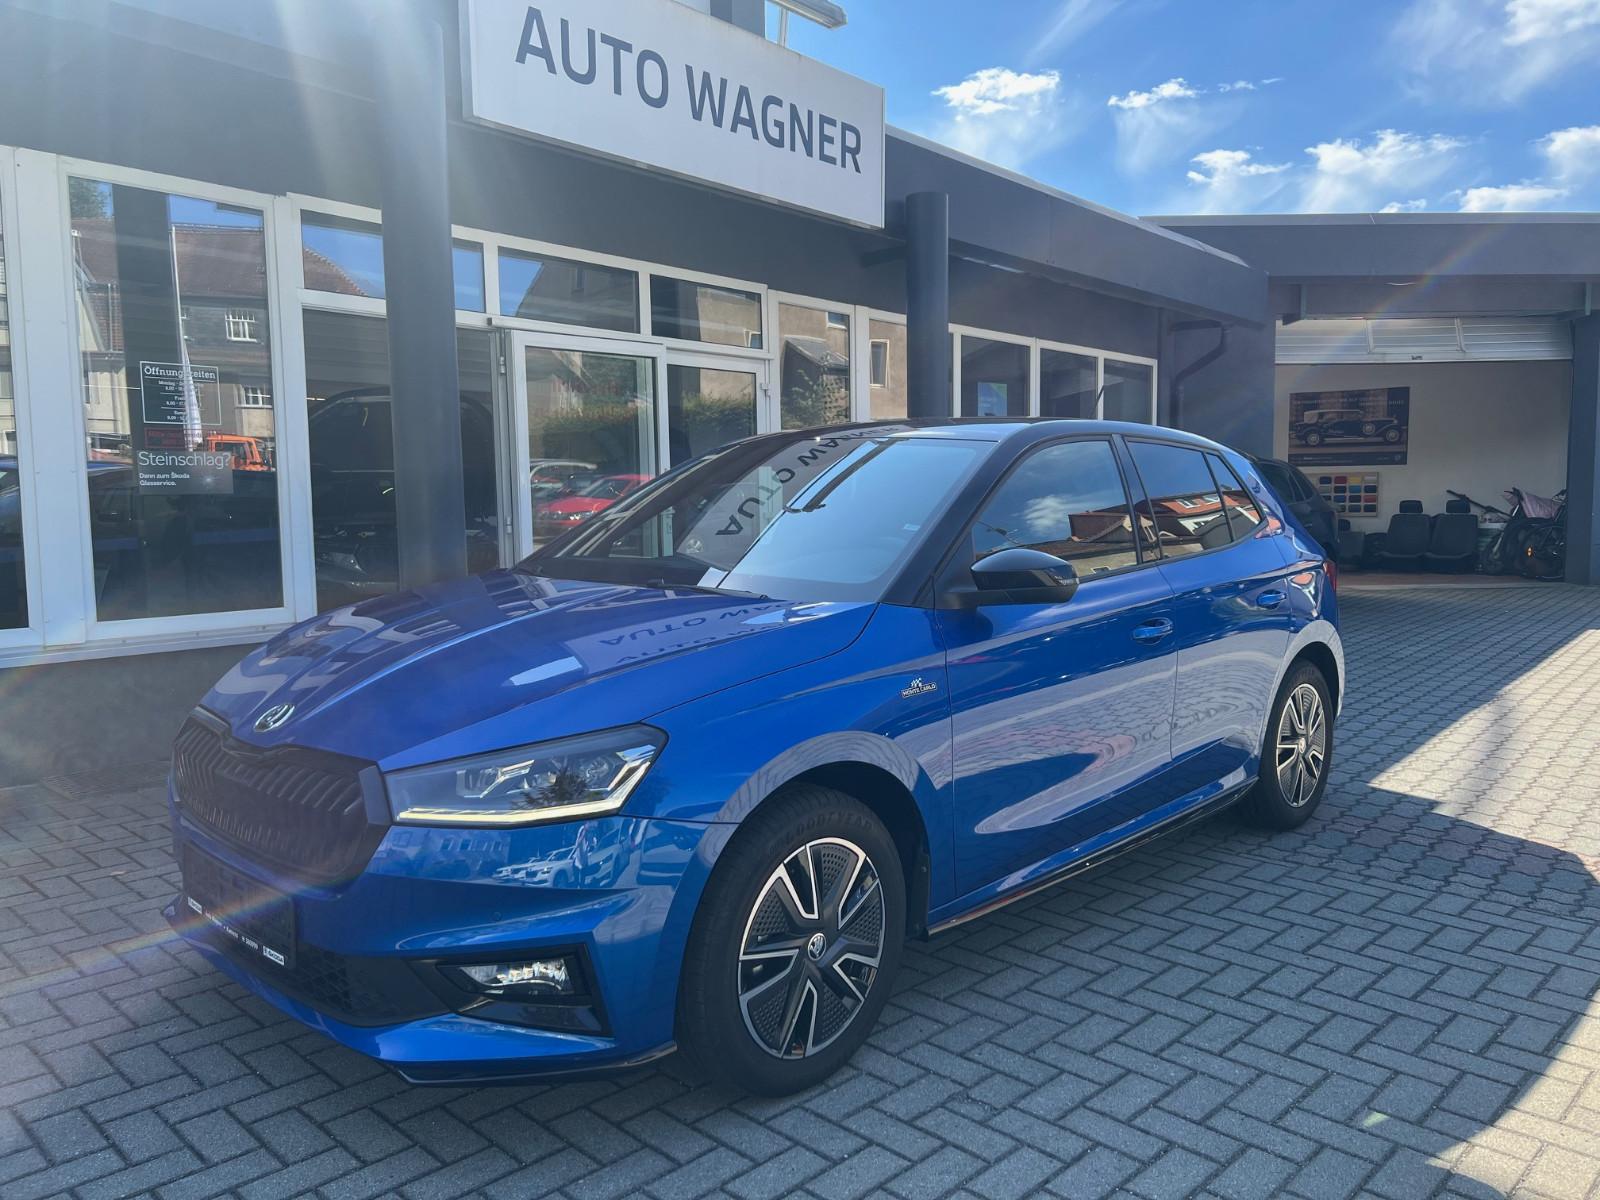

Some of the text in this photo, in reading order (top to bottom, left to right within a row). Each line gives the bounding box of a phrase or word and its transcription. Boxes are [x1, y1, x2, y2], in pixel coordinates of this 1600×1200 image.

[515, 5, 862, 174] AUTO WAGNER
[144, 366, 216, 379] Öffnungeiten
[138, 451, 231, 470] Steinschlag?
[902, 688, 920, 697] MONTE
